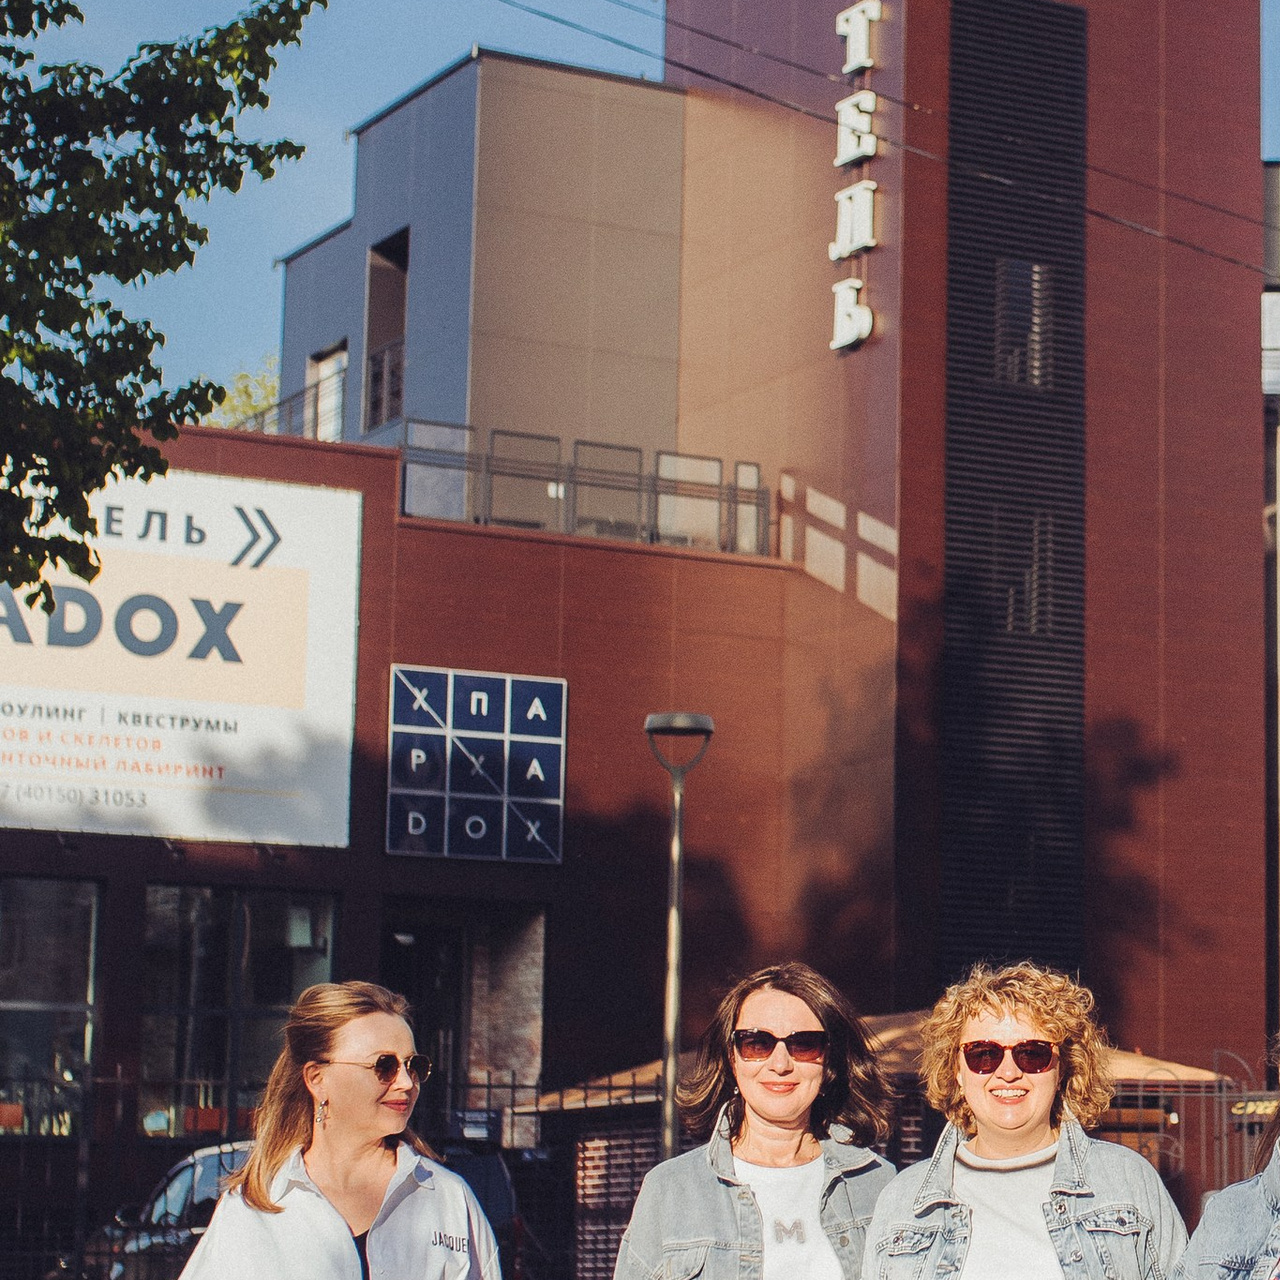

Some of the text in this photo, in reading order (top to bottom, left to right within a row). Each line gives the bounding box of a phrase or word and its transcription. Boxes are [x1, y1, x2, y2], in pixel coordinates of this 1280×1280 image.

[104, 505, 207, 545] ЕЛЬ
[117, 710, 238, 734] КВЕСТРУМЫ
[60, 730, 163, 752] СКЕЛЕТОВ
[115, 758, 226, 780] ЛАБИРИНТ
[88, 786, 147, 808] 31053
[774, 1219, 806, 1244] M
